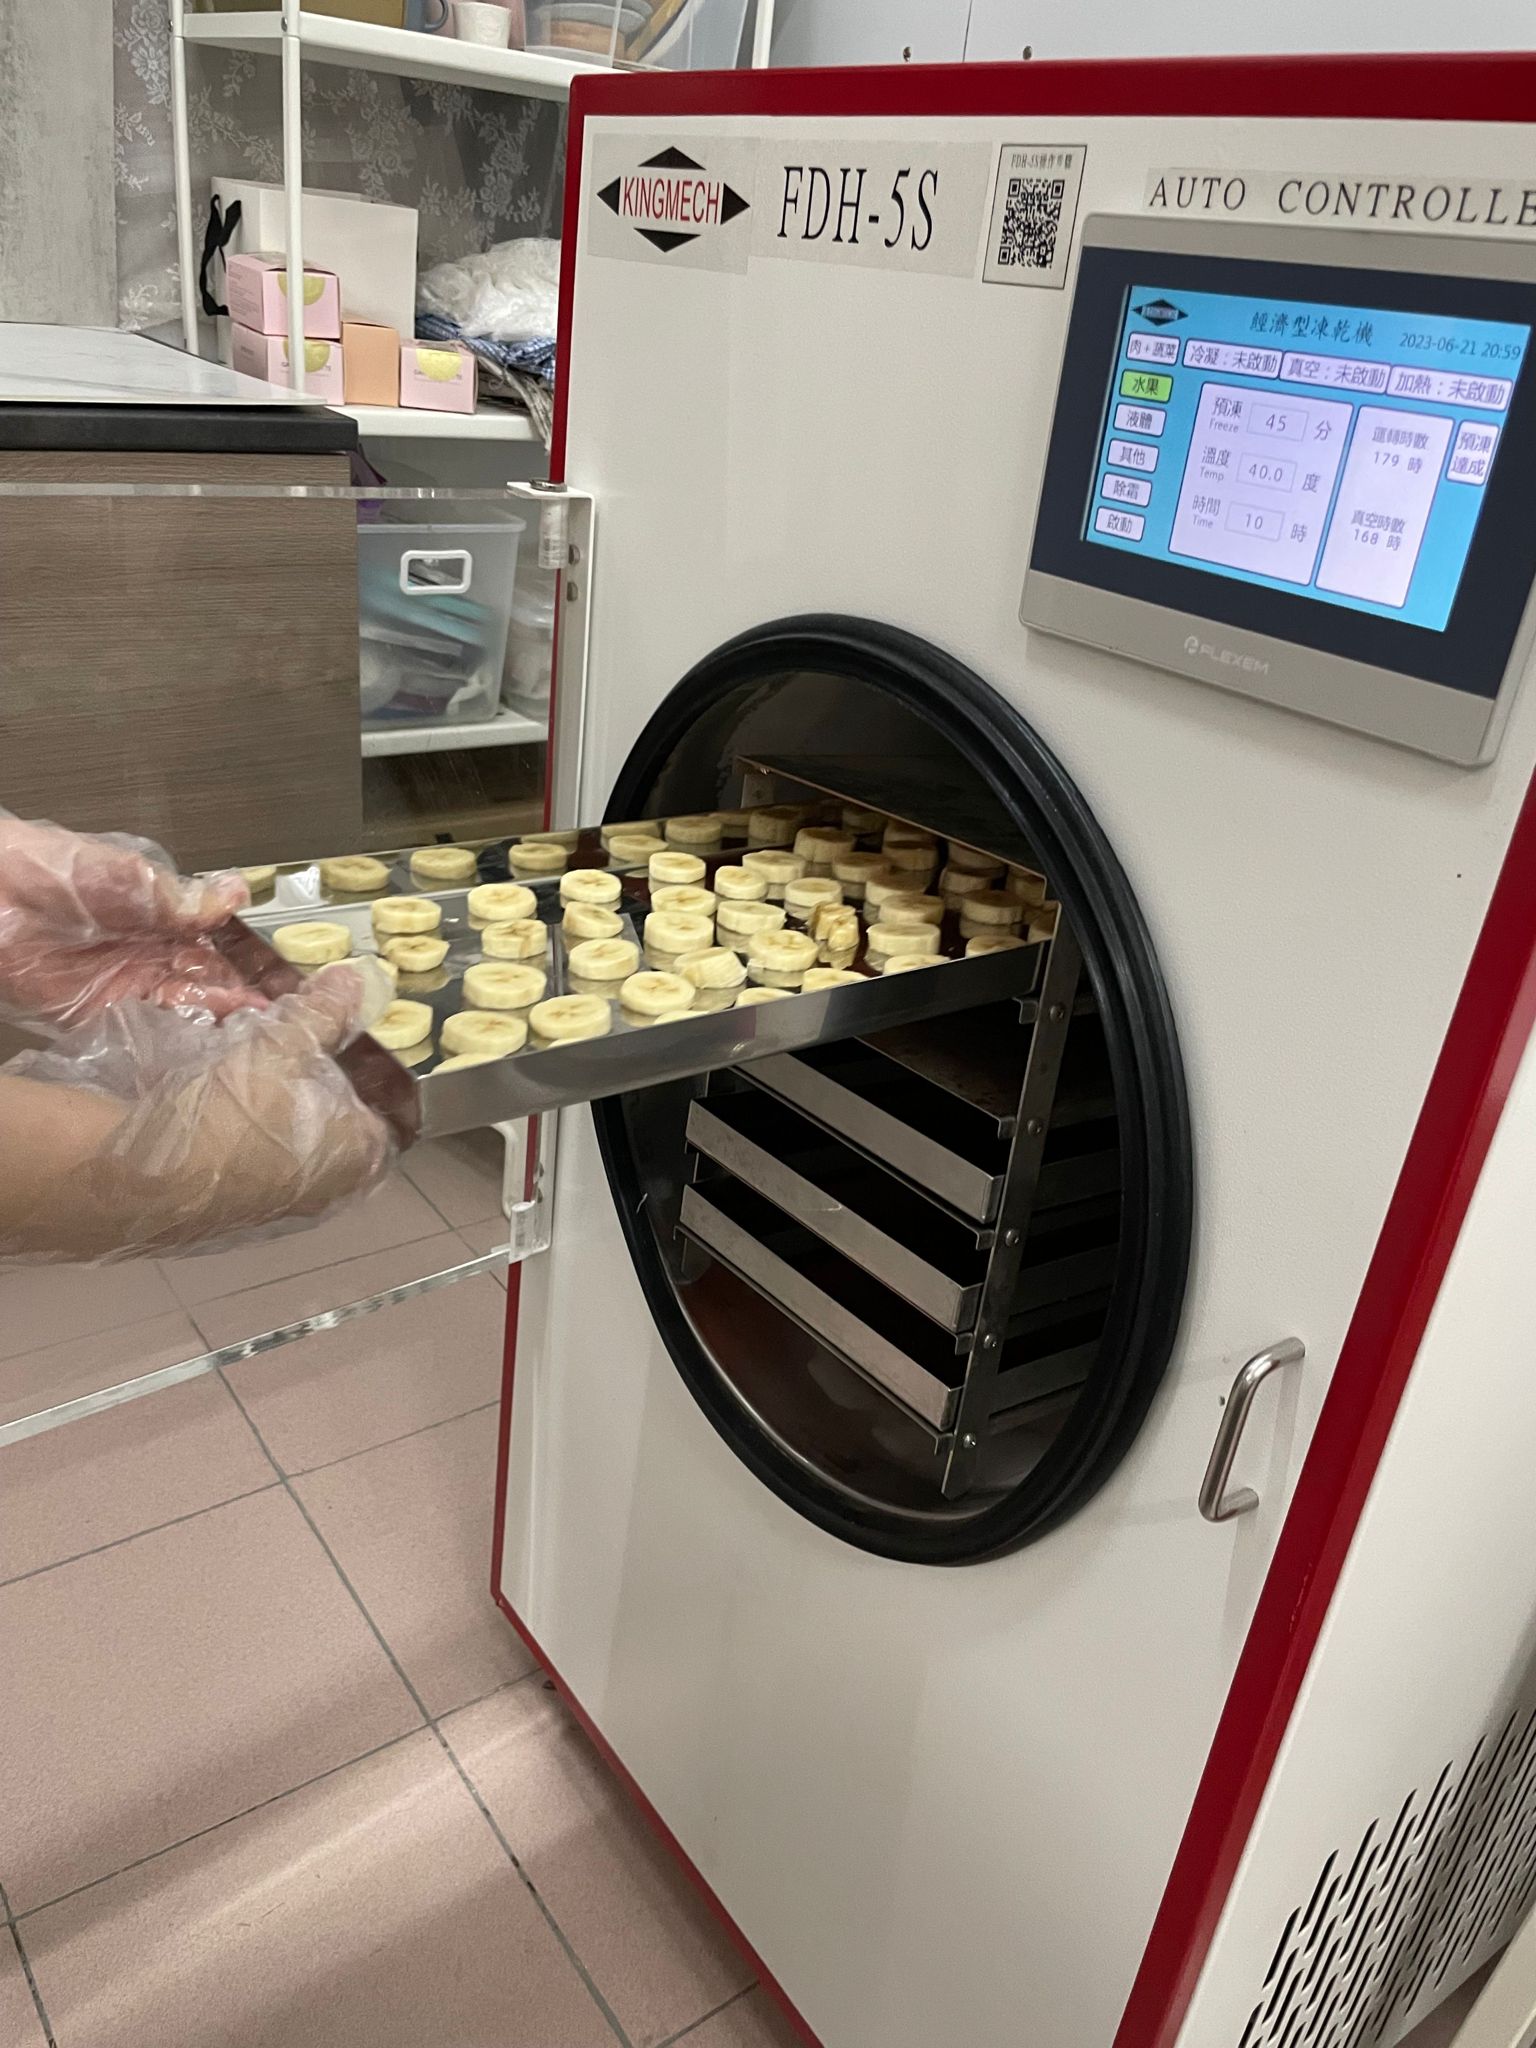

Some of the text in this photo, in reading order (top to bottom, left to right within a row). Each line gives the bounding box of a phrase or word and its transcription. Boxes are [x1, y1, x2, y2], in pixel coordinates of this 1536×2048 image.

[622, 175, 720, 225] KINGMECH
[1149, 176, 1247, 211] AUTO
[777, 165, 938, 251] FDH-5S
[1249, 310, 1374, 348] 經濟型凍乾機
[1399, 332, 1521, 361] 2023-06-21 20:59
[1133, 376, 1159, 396] 水果
[1125, 409, 1153, 430] 液體
[1209, 418, 1239, 433] Freeze
[1211, 396, 1332, 441] 預凍 45 分
[1371, 426, 1430, 450] 運轉時數
[1457, 431, 1493, 454] 預凍
[1119, 445, 1146, 466] 其他
[1373, 451, 1424, 475] 179 時
[1450, 455, 1486, 477] 達成
[1199, 467, 1225, 481] Temp
[1201, 446, 1321, 493] 溫度 40.0 度
[1112, 479, 1140, 501] 除霜
[1106, 513, 1134, 535] 啟動
[1191, 495, 1308, 543] 時間 10 時
[1191, 517, 1214, 530] Time
[1351, 510, 1406, 534] 真空時數
[1353, 529, 1401, 551] 168 時
[1200, 643, 1269, 675] FLEXEM
